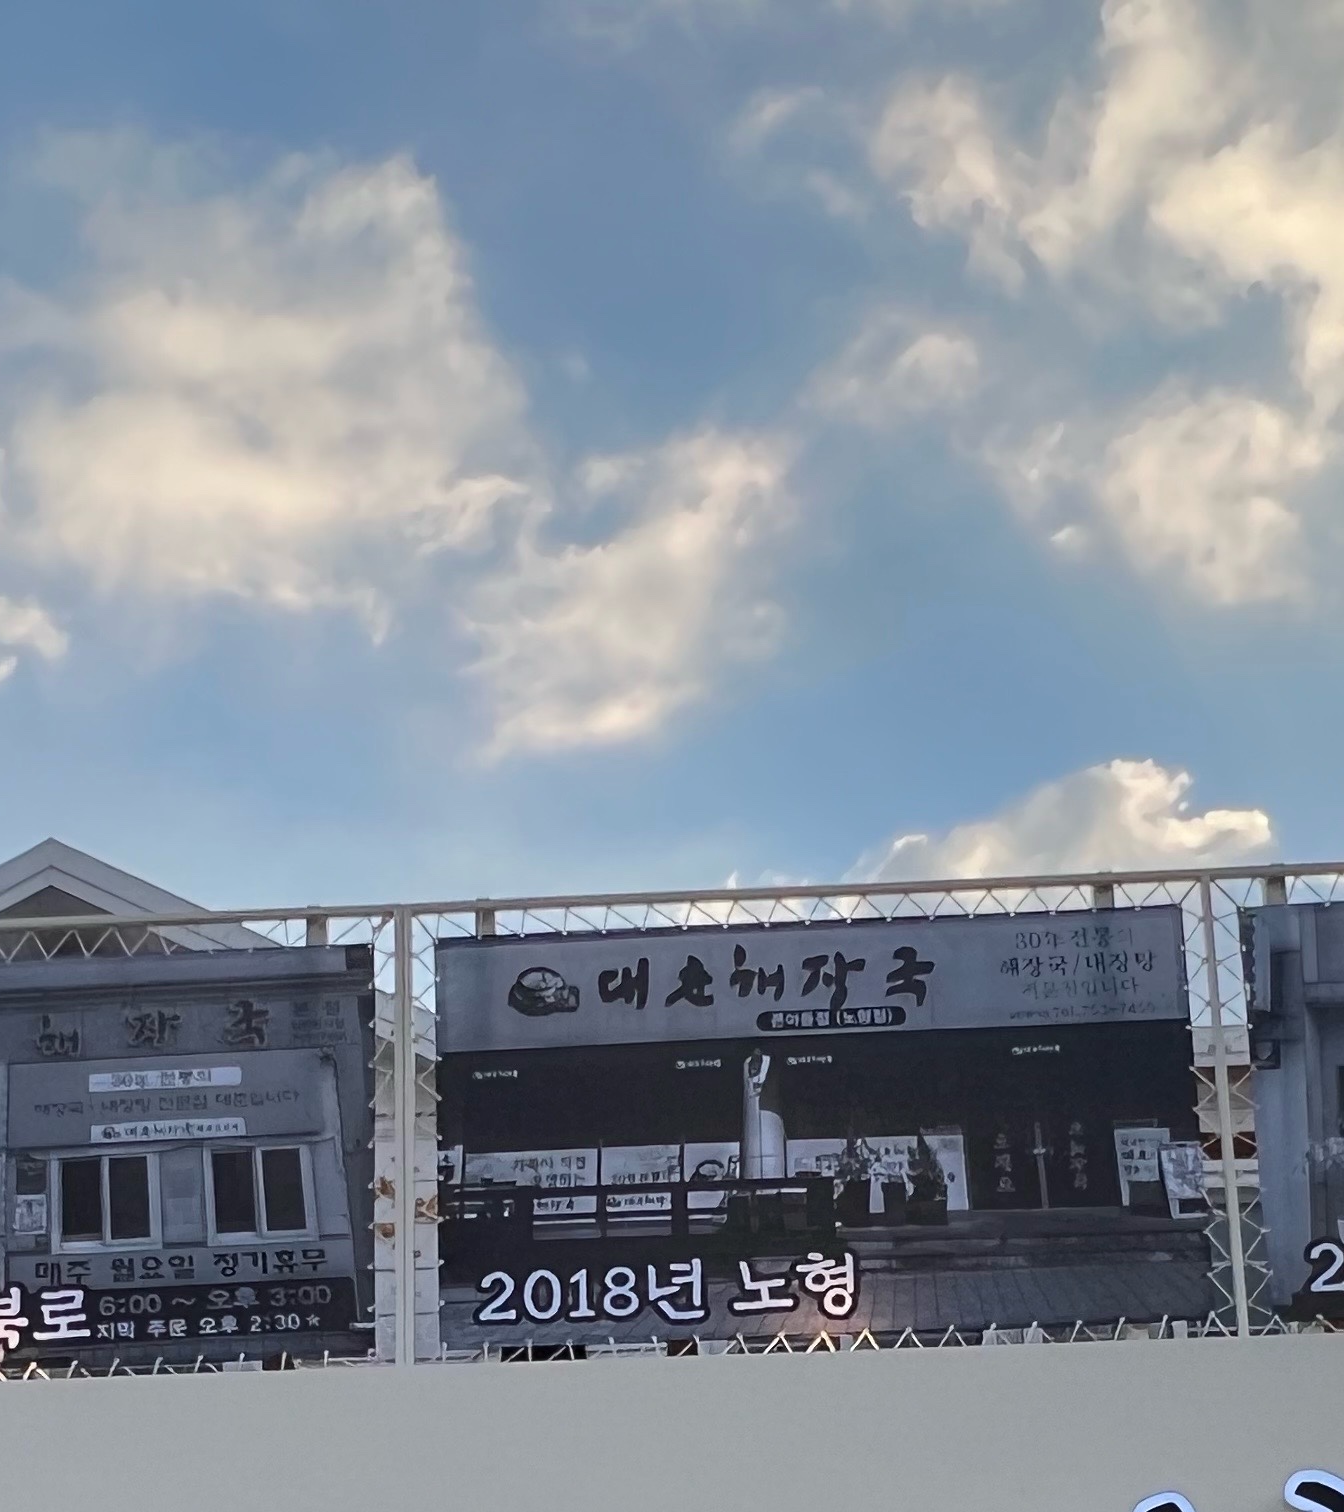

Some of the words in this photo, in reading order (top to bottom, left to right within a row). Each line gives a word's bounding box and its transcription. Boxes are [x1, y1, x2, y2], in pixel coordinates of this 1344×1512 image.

[34, 1260, 93, 1286] 매주
[110, 1254, 196, 1283] 월요일
[212, 1248, 327, 1278] 정기휴무
[98, 1293, 162, 1318] 6:00
[269, 1285, 333, 1307] 3:00
[477, 1258, 704, 1323] 2018년
[732, 1250, 856, 1318] 노형
